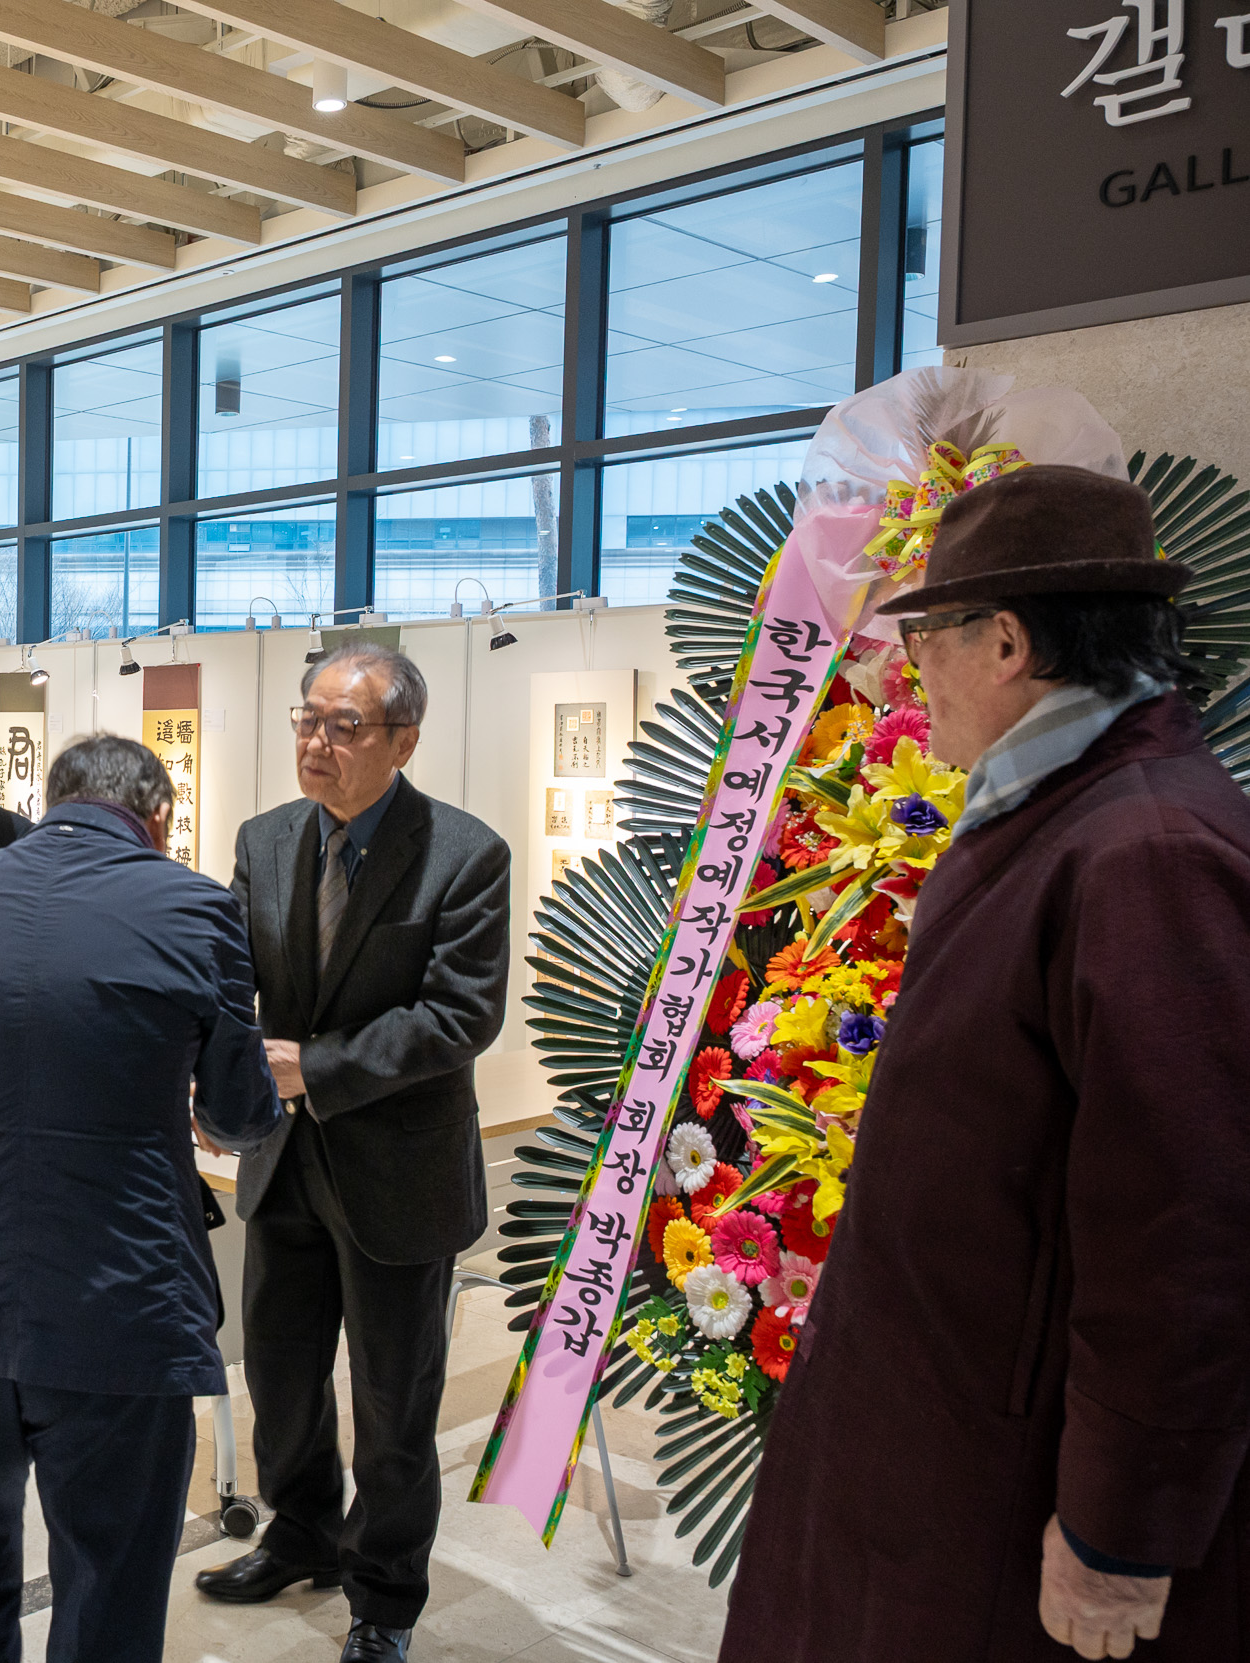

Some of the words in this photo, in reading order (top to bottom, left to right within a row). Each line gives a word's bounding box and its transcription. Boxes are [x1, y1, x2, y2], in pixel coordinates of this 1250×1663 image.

[1060, 0, 1250, 127] 갤
[1099, 147, 1250, 208] GALL
[603, 1098, 656, 1195] 회장
[553, 1210, 631, 1357] 박종갑
